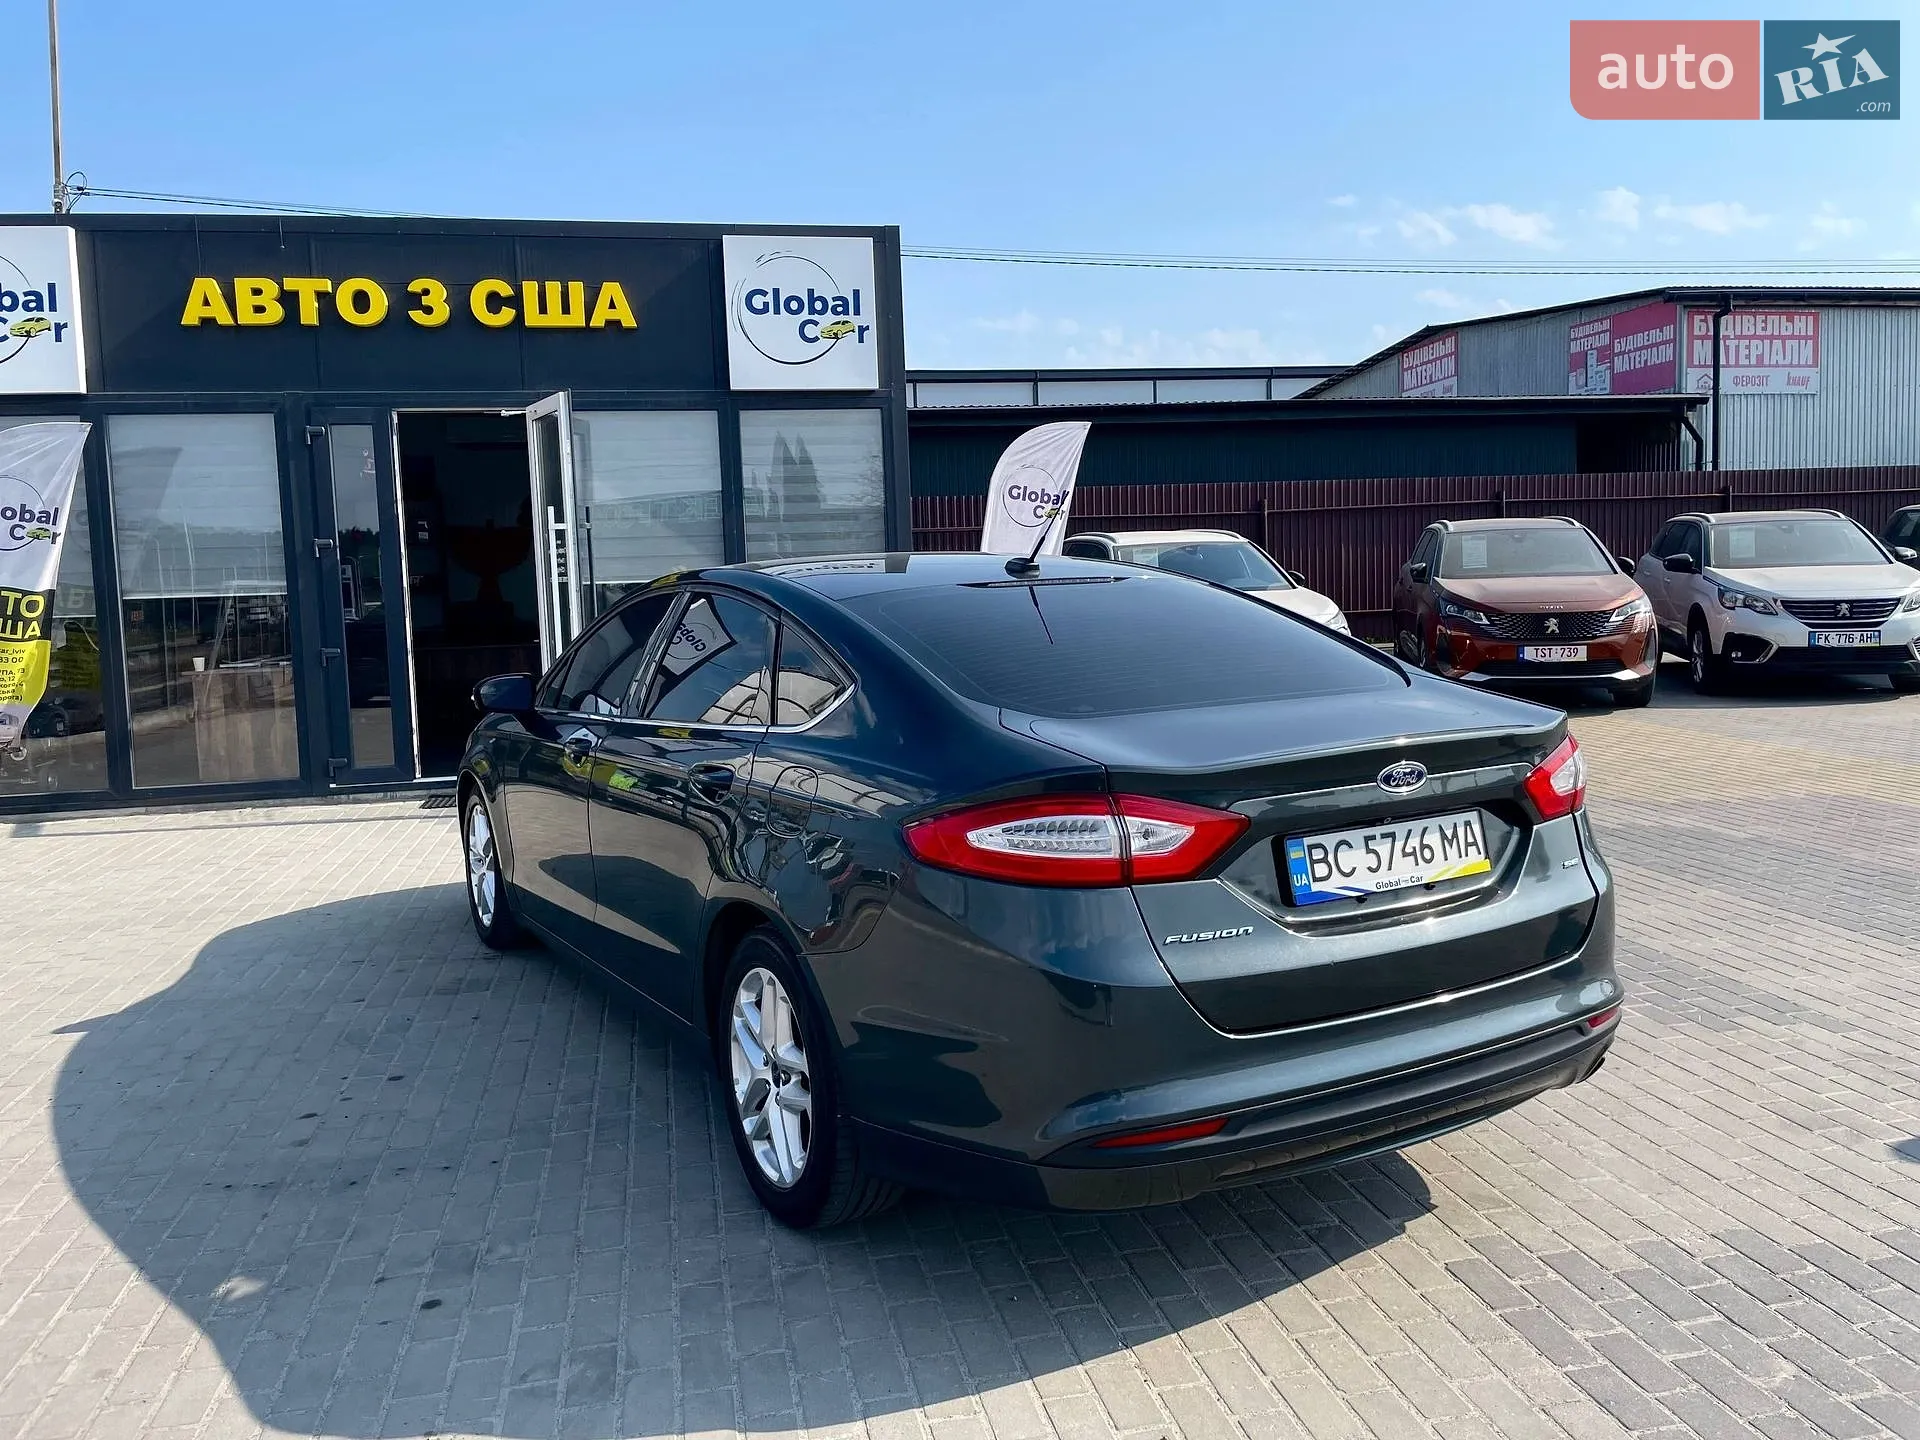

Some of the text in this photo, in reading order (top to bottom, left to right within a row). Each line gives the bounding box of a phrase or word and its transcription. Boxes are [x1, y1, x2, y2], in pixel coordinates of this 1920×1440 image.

[181, 277, 638, 328] АВТО З США
[744, 287, 861, 316] Global
[1570, 319, 1610, 339] БУДІВЕЛЬНІ
[1614, 324, 1674, 354] БУДІВЕЛЬНІ
[1403, 335, 1455, 369] БУДІВЕЛЬНІ
[1570, 331, 1610, 354] МАТЕРІАЛИ
[1614, 342, 1674, 374] МАТЕРІАЛИ
[1403, 355, 1455, 391] МАТЕРІАЛИ
[1817, 632, 1873, 644] FK-776-AH
[1534, 647, 1579, 658] TST 739
[1390, 768, 1418, 786] Ford
[1306, 820, 1482, 883] BC 5746 MA
[1293, 874, 1309, 887] UA
[1375, 875, 1424, 890] Global Car
[1162, 926, 1255, 946] FUSION
